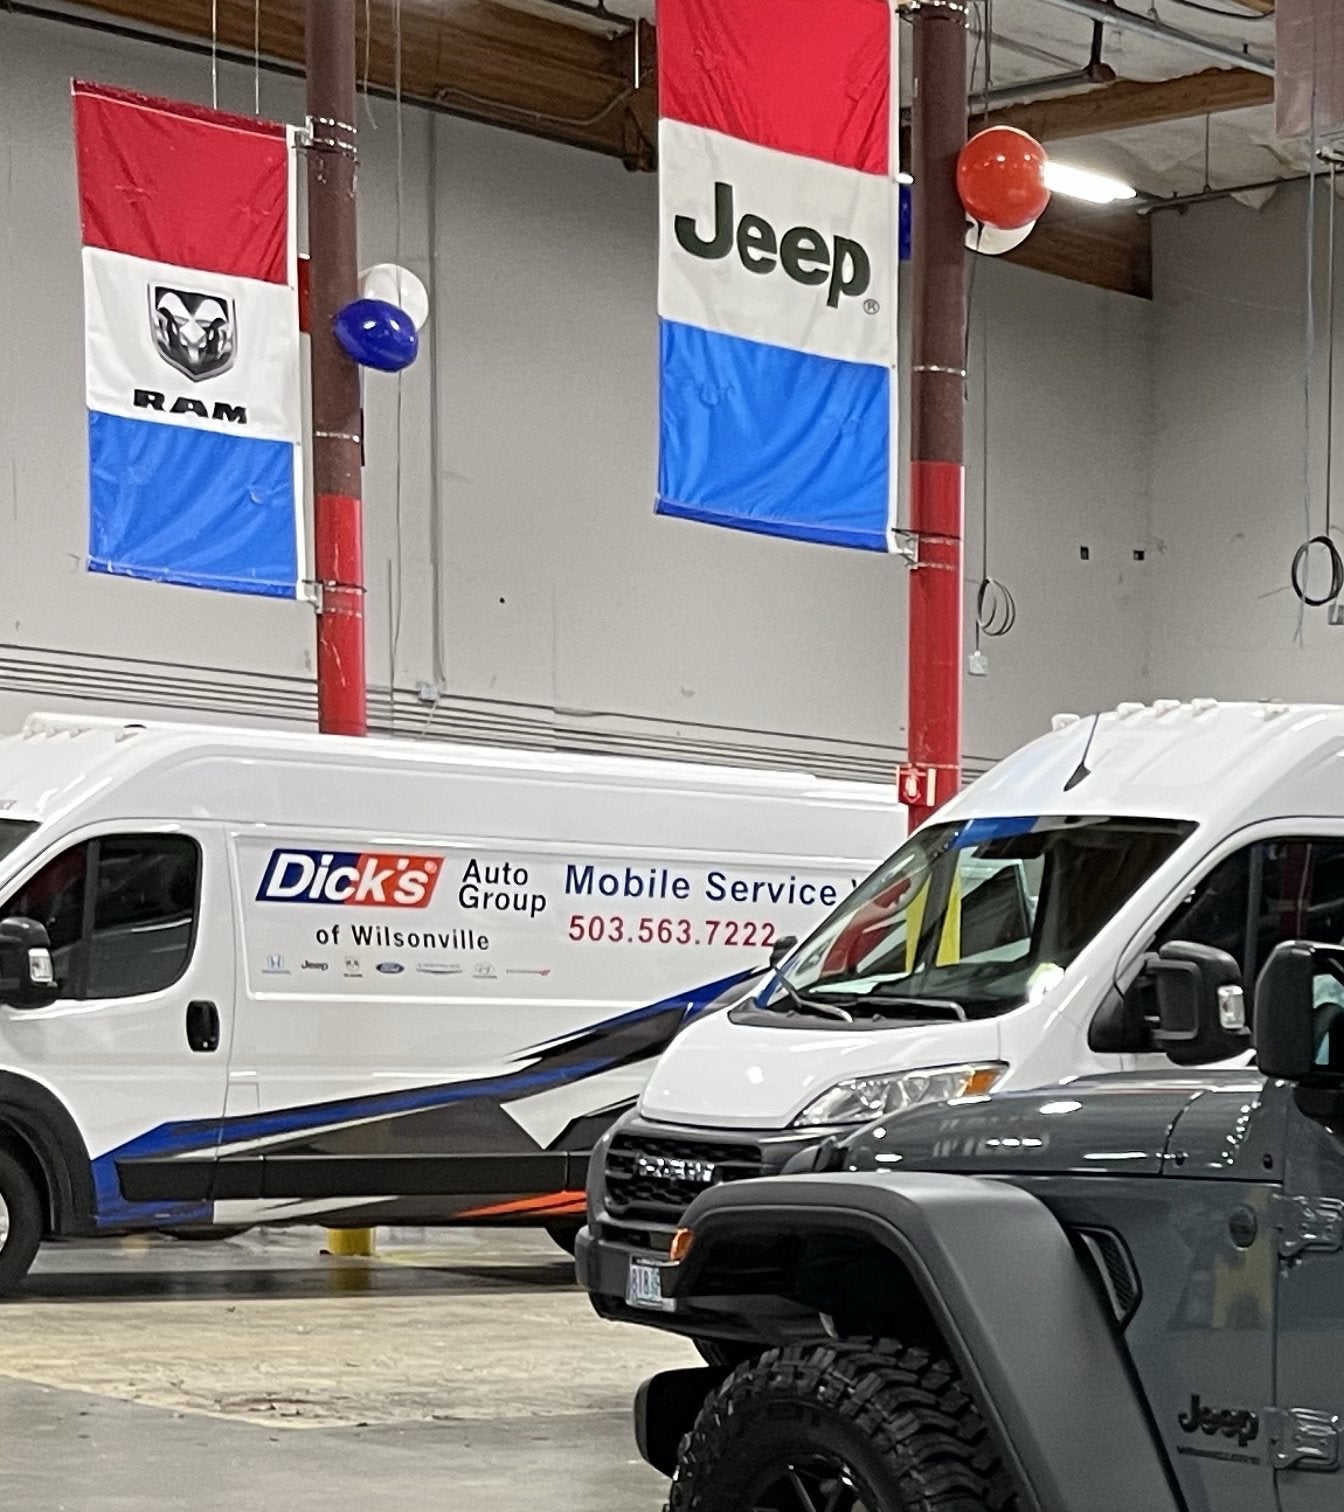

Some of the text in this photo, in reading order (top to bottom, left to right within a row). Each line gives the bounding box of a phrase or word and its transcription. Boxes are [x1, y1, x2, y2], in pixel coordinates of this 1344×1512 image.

[674, 181, 871, 309] Jeep
[133, 388, 247, 424] RAM
[266, 853, 430, 904] Dick's
[462, 859, 528, 886] Auto
[565, 864, 837, 906] Mobile Service
[459, 884, 547, 918] Group
[316, 925, 489, 950] of Wilsonville
[568, 915, 775, 948] 503.563.7222
[1178, 1394, 1259, 1447] Jeep
